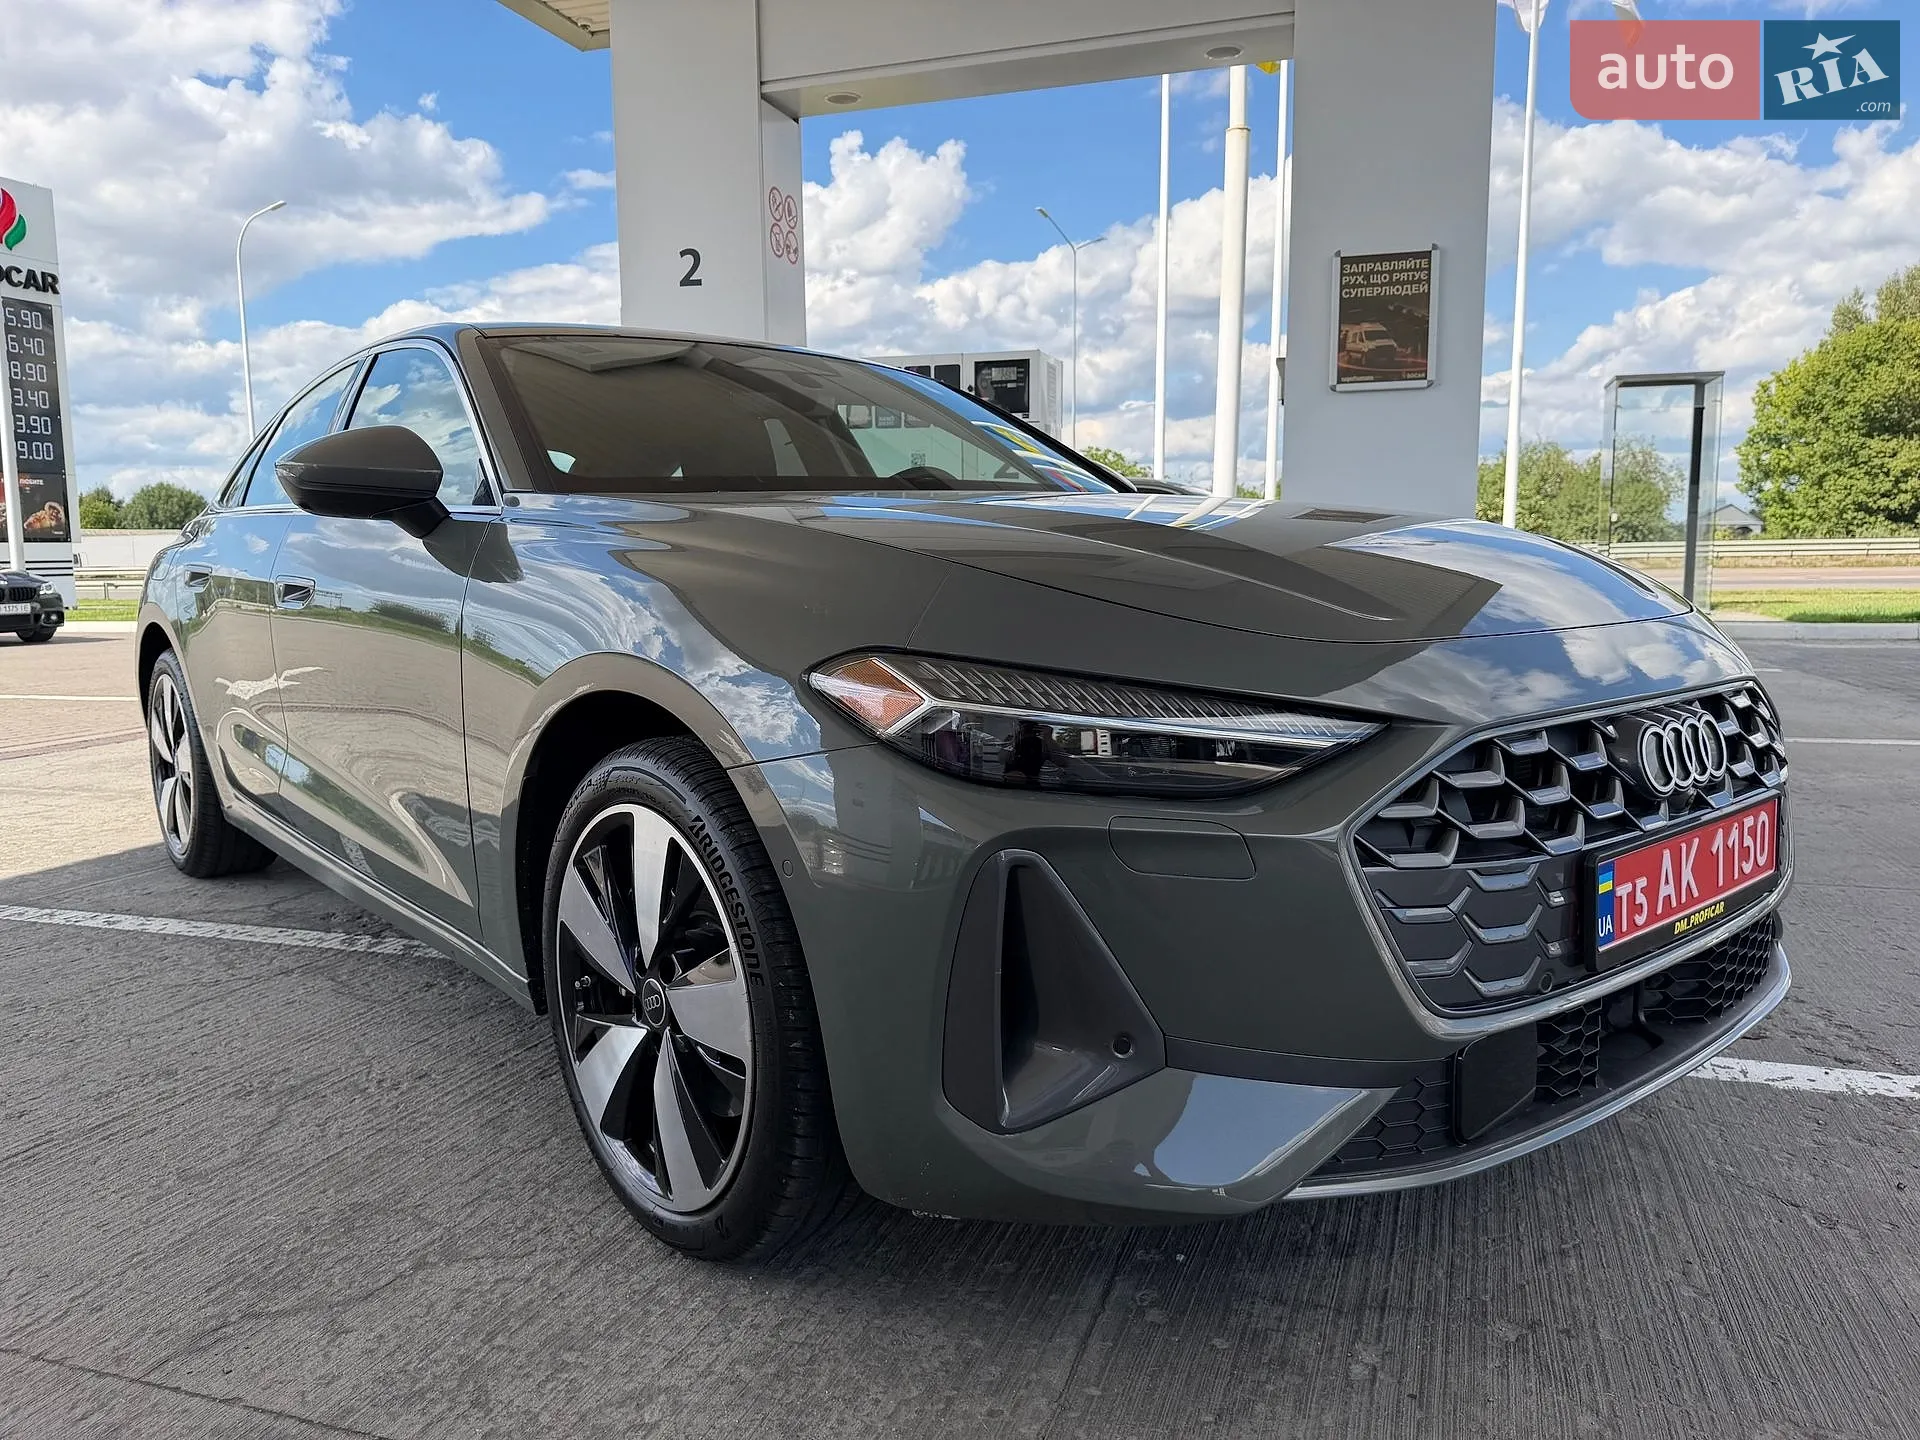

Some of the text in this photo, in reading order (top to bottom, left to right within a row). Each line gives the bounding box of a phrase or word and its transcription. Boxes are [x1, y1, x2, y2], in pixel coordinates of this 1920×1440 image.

[679, 248, 703, 287] 2
[1342, 270, 1428, 285] РУХ, ЩО РЯТУЄ
[1343, 258, 1429, 274] ЗАПРАВЛЯЙТЕ
[1342, 281, 1428, 298] СУПЕРЛЮДЕЙ
[1615, 810, 1769, 933] T5 AK 1150
[688, 815, 764, 988] BRIDGESTONE
[1598, 914, 1613, 938] UA
